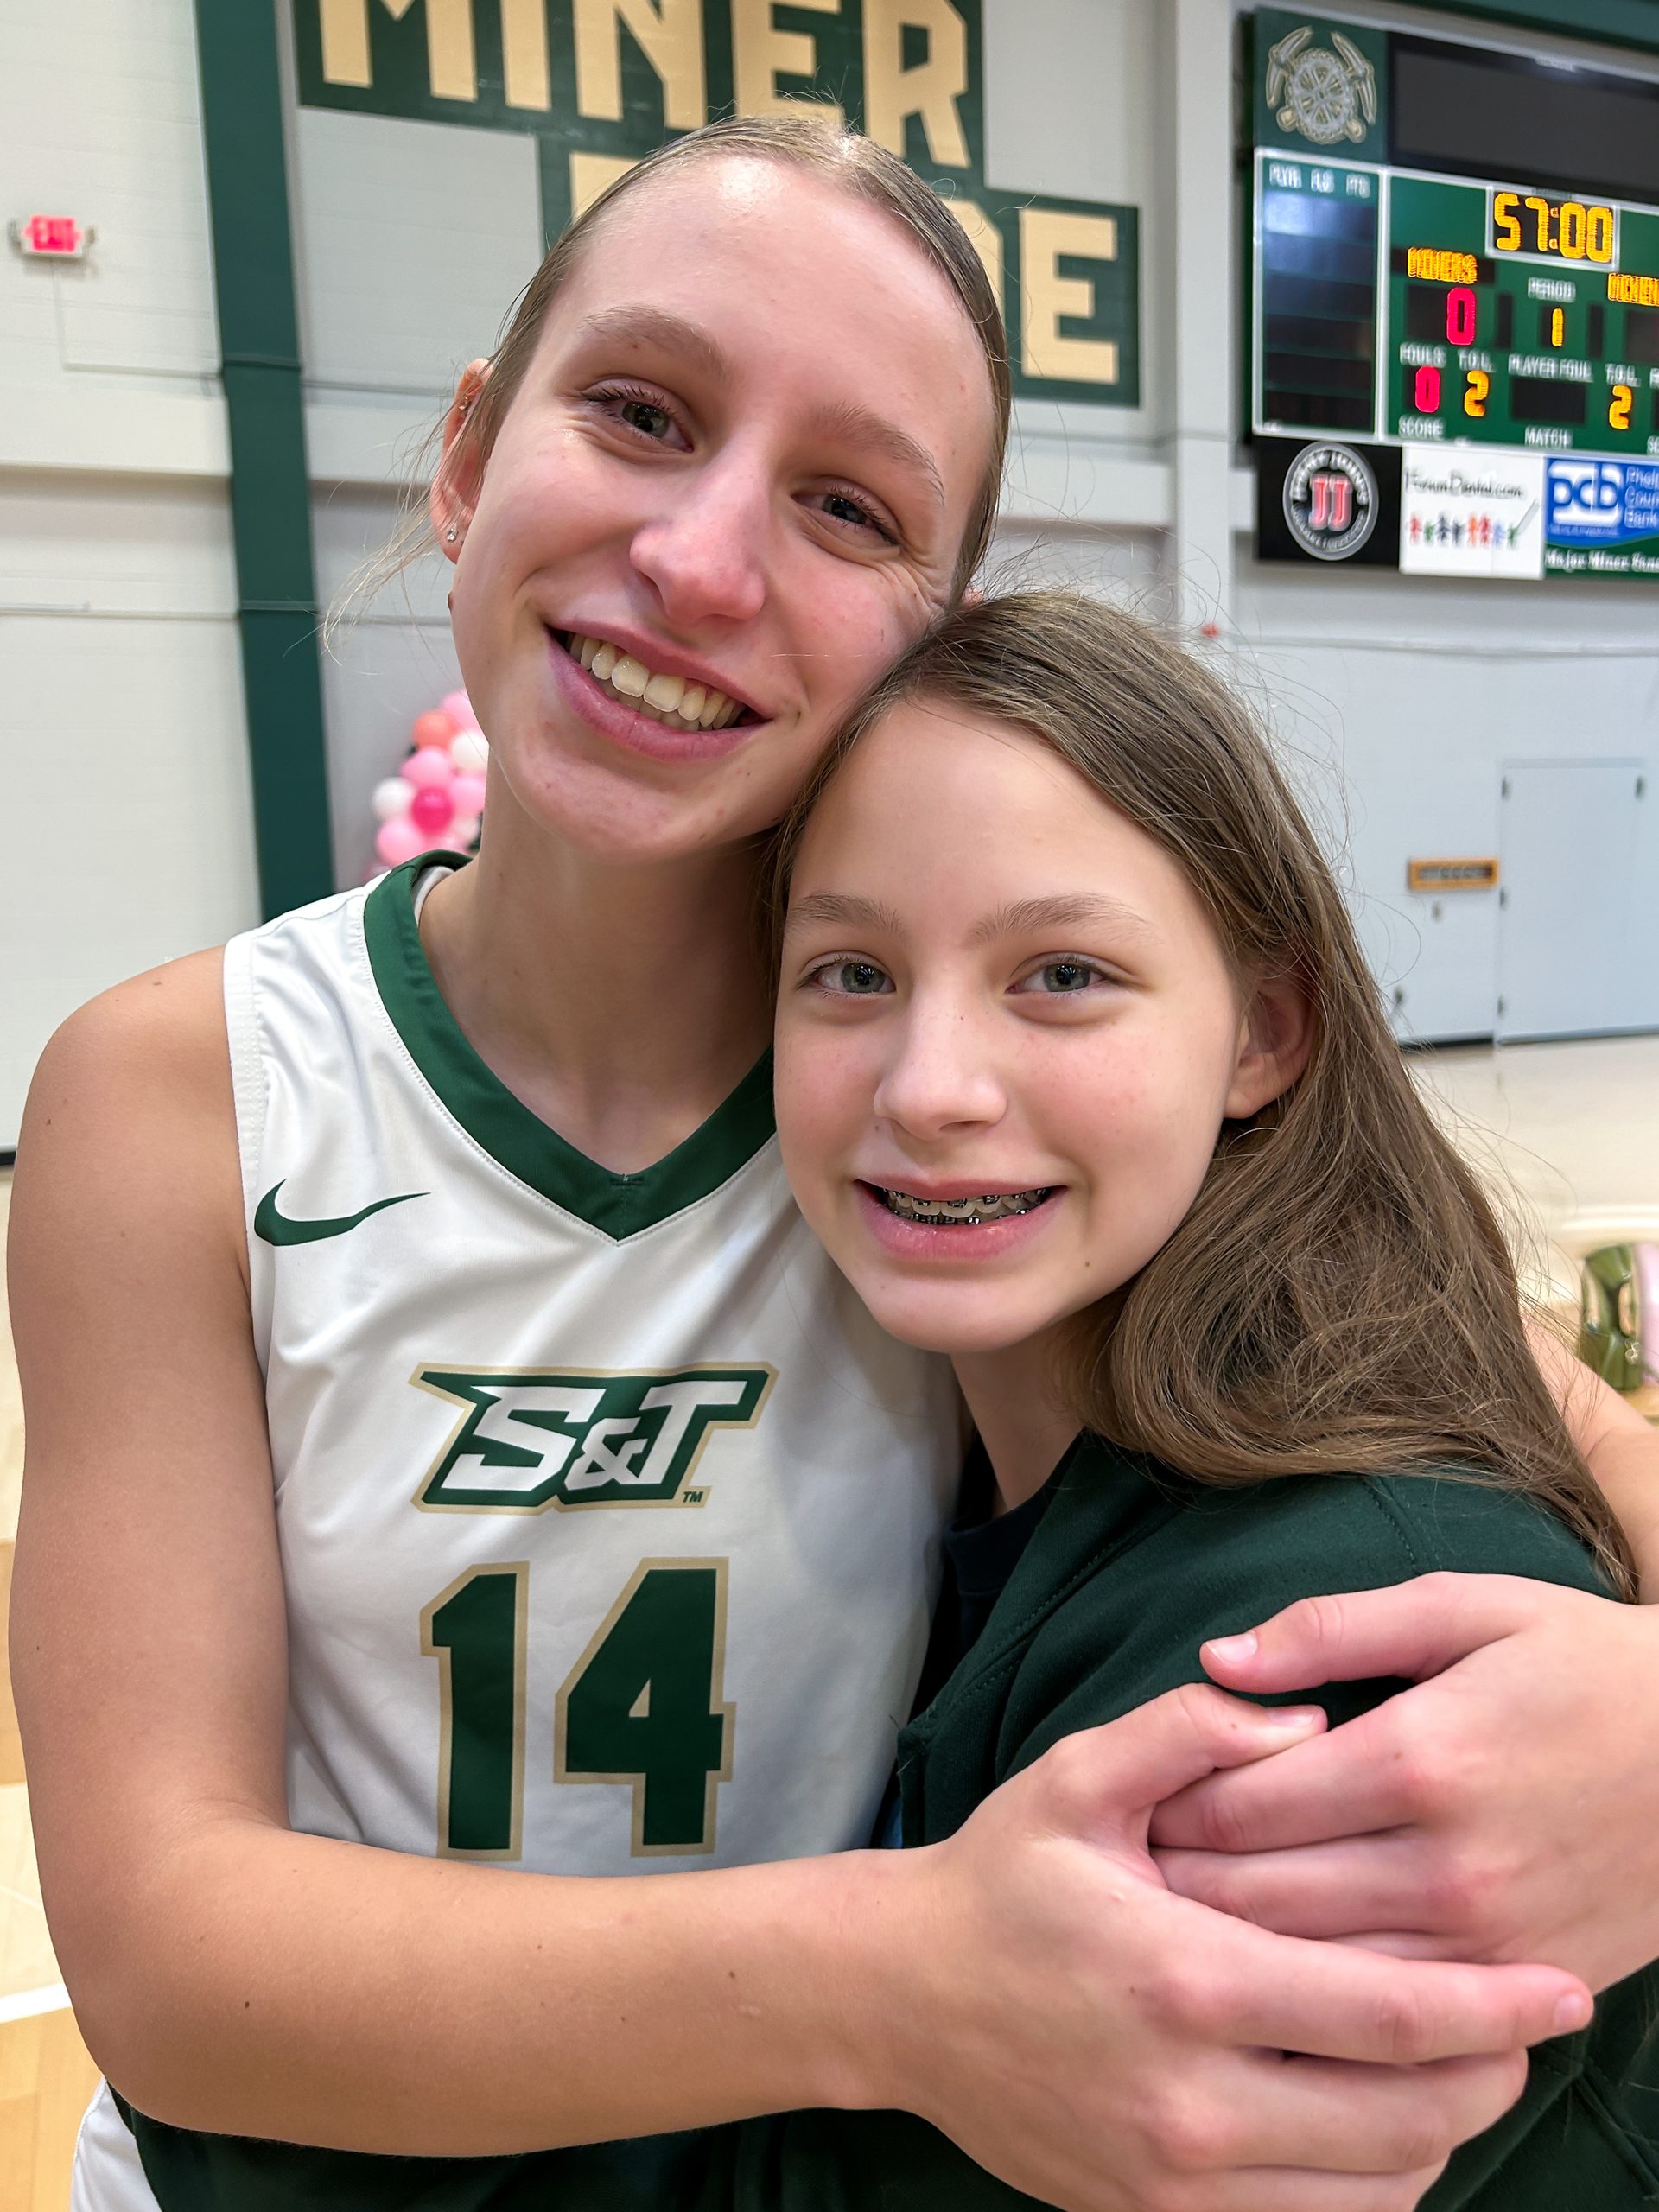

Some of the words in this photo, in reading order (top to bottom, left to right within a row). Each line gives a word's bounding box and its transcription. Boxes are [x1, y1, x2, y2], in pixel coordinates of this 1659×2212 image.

[1494, 193, 1614, 263] 57:00
[1528, 276, 1576, 302] PERIOD
[1446, 287, 1477, 346] 0
[1552, 308, 1564, 347] 1
[1400, 342, 1446, 368] FOULS
[1508, 353, 1558, 379] PLAYER
[1415, 365, 1440, 413] 0
[1464, 370, 1490, 417] 2
[1609, 385, 1632, 429] 2
[1399, 415, 1446, 441] SCORE
[1524, 425, 1573, 449] MATCH
[440, 1380, 748, 1491] S&T
[419, 1556, 737, 1861] 14
